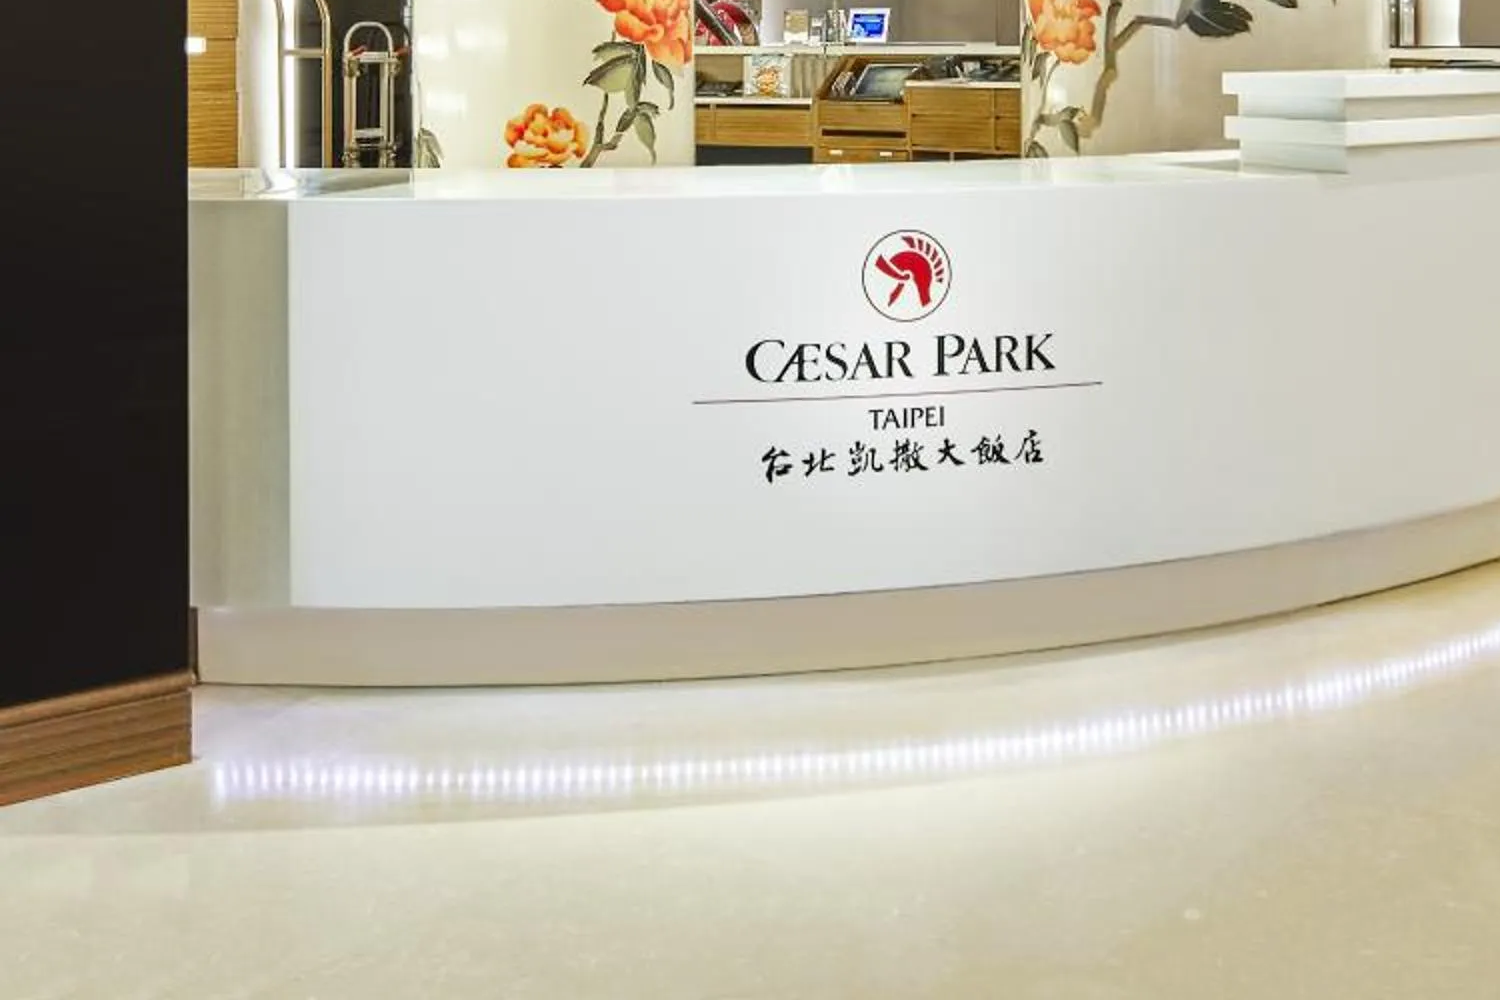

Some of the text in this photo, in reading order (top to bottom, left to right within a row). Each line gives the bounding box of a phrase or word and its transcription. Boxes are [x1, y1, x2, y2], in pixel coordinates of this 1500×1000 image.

[745, 333, 1056, 383] CÆSAR PARK
[868, 405, 945, 431] TAIPEI
[761, 429, 1045, 484] 台北凱撒大飯店
